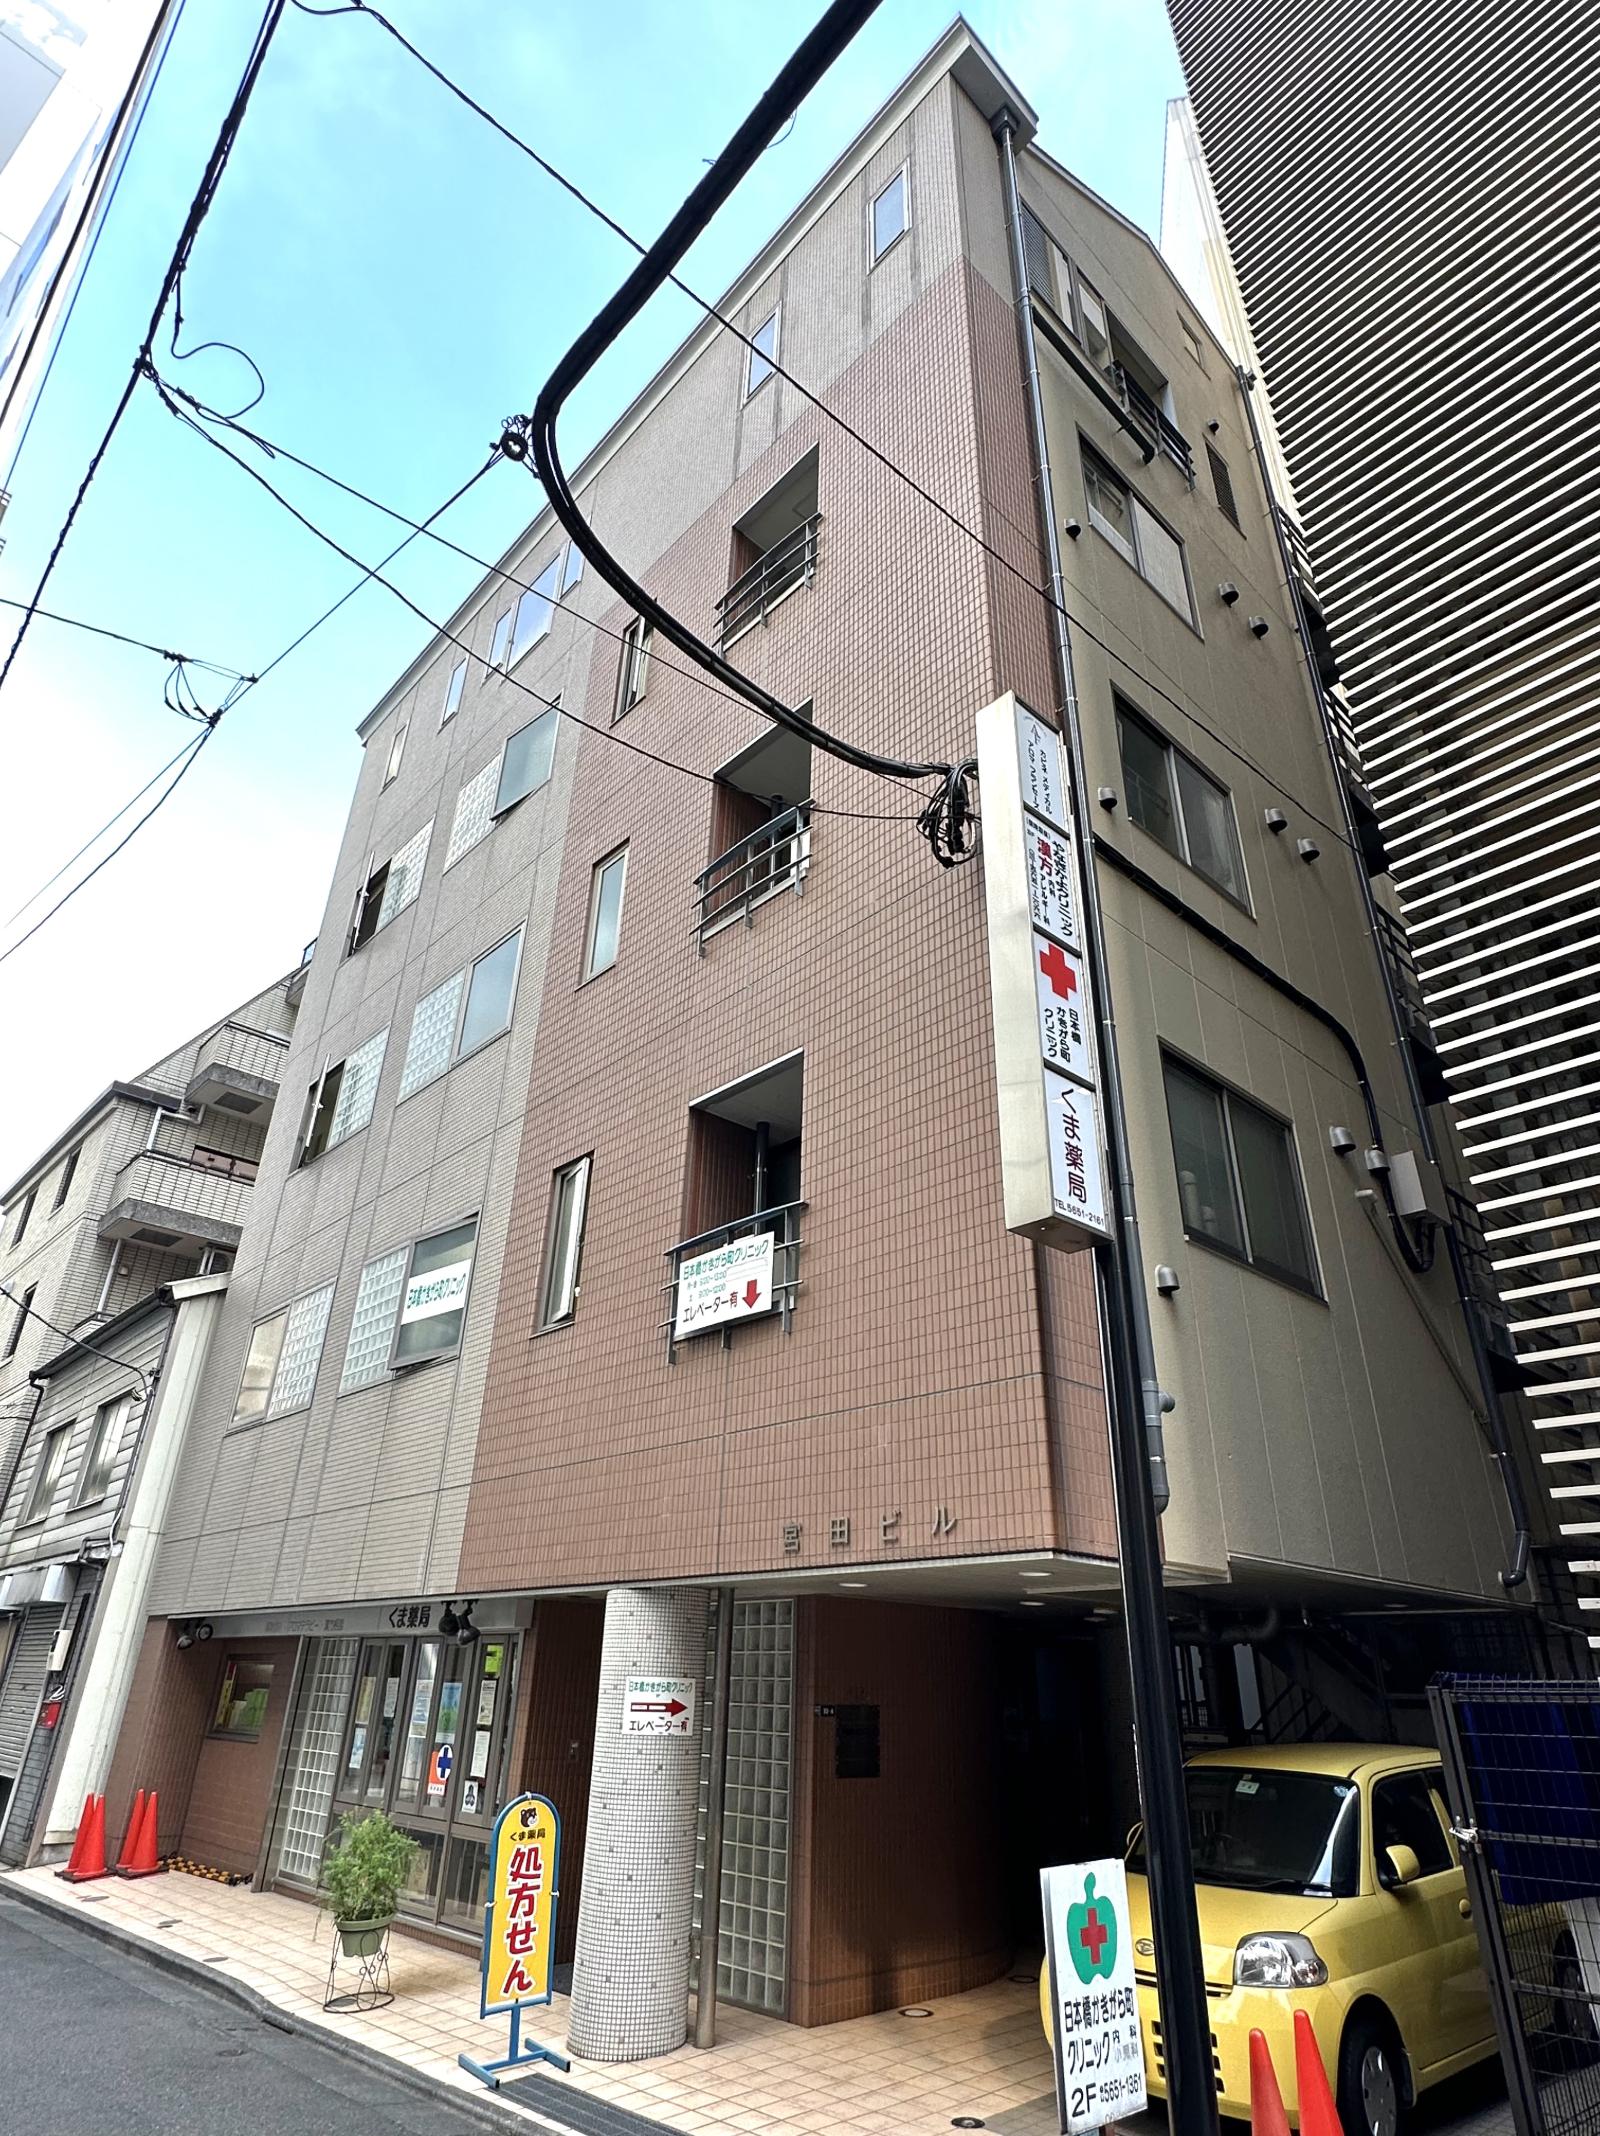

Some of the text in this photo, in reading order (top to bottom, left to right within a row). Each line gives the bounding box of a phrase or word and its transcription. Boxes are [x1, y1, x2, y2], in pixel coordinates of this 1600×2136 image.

[1037, 837, 1053, 877] 漢方
[1044, 1007, 1057, 1058] クリニック
[1056, 1006, 1070, 1063] かきがら町
[1069, 1007, 1082, 1045] 日本橋
[1062, 1088, 1087, 1204] くま薬局
[683, 1291, 738, 1323] エレベーター有
[783, 1504, 958, 1554] 宮田ビル
[389, 1604, 431, 1628] くま薬局
[628, 1681, 693, 1694] 日本橋かきがら町クリニック
[629, 1717, 688, 1733] エレベーター有
[509, 1827, 546, 1841] くま薬局
[503, 1846, 542, 1995] 処方せん
[1064, 1986, 1135, 2033] 日本橋かきがら町
[1068, 2031, 1110, 2075] クリニック
[1071, 2082, 1097, 2118] 2F
